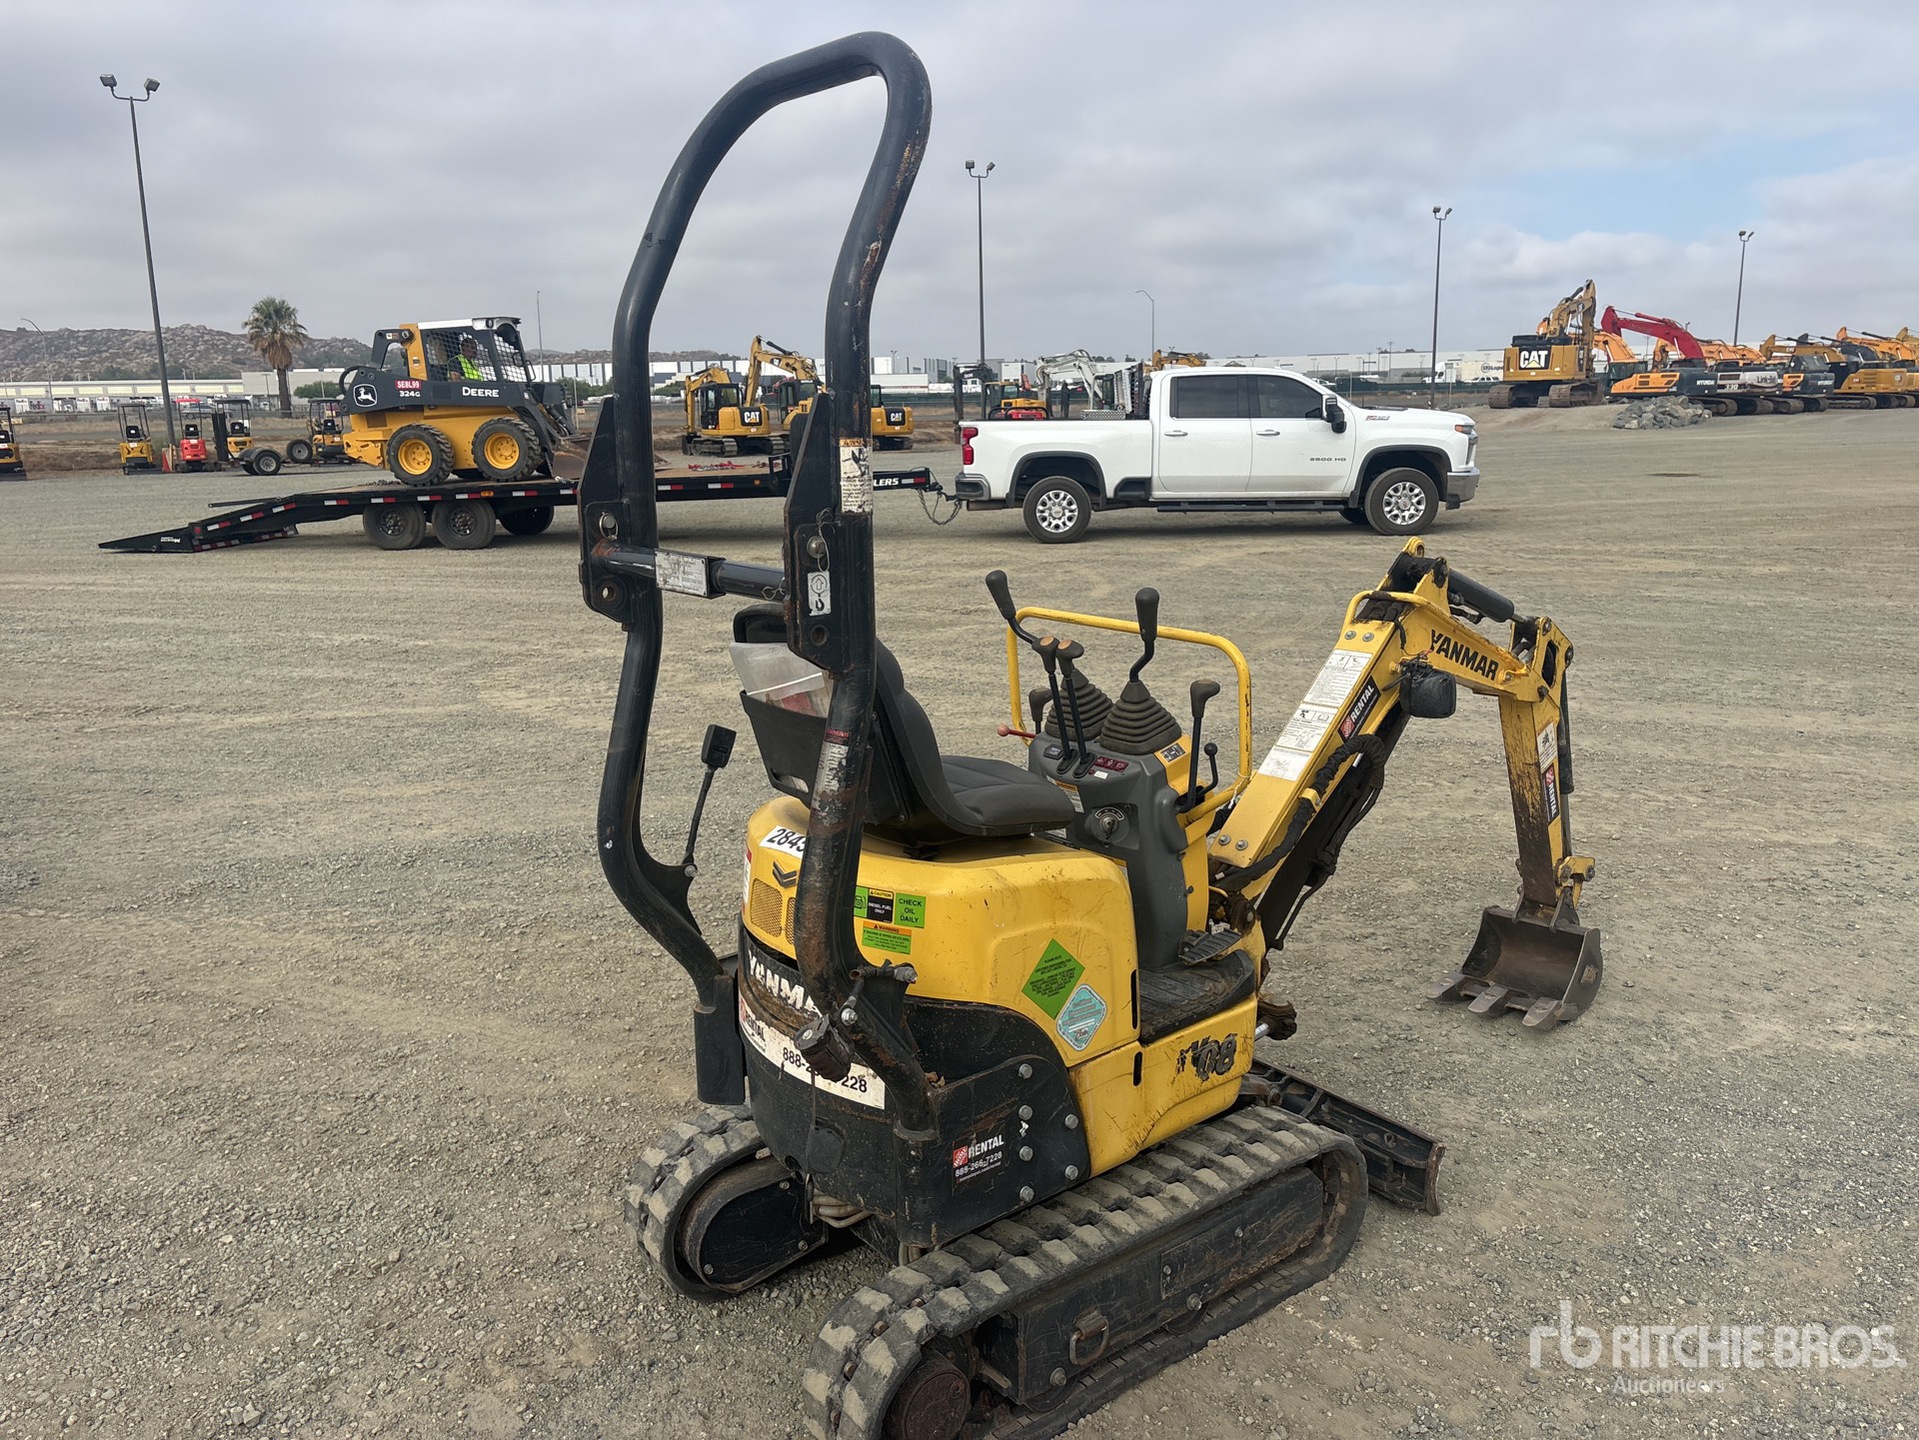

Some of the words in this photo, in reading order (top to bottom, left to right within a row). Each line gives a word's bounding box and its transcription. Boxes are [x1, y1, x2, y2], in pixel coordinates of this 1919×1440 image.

[1520, 350, 1549, 368] CAT
[462, 386, 500, 398] DEERE
[743, 411, 761, 424] CAT
[890, 412, 903, 423] CAT
[873, 477, 900, 487] LERS
[1430, 629, 1499, 681] YANMAR
[1350, 685, 1375, 722] RENTAL
[898, 897, 923, 907] CHECK
[900, 914, 919, 923] DAILY
[968, 1134, 1005, 1158] RENTAL
